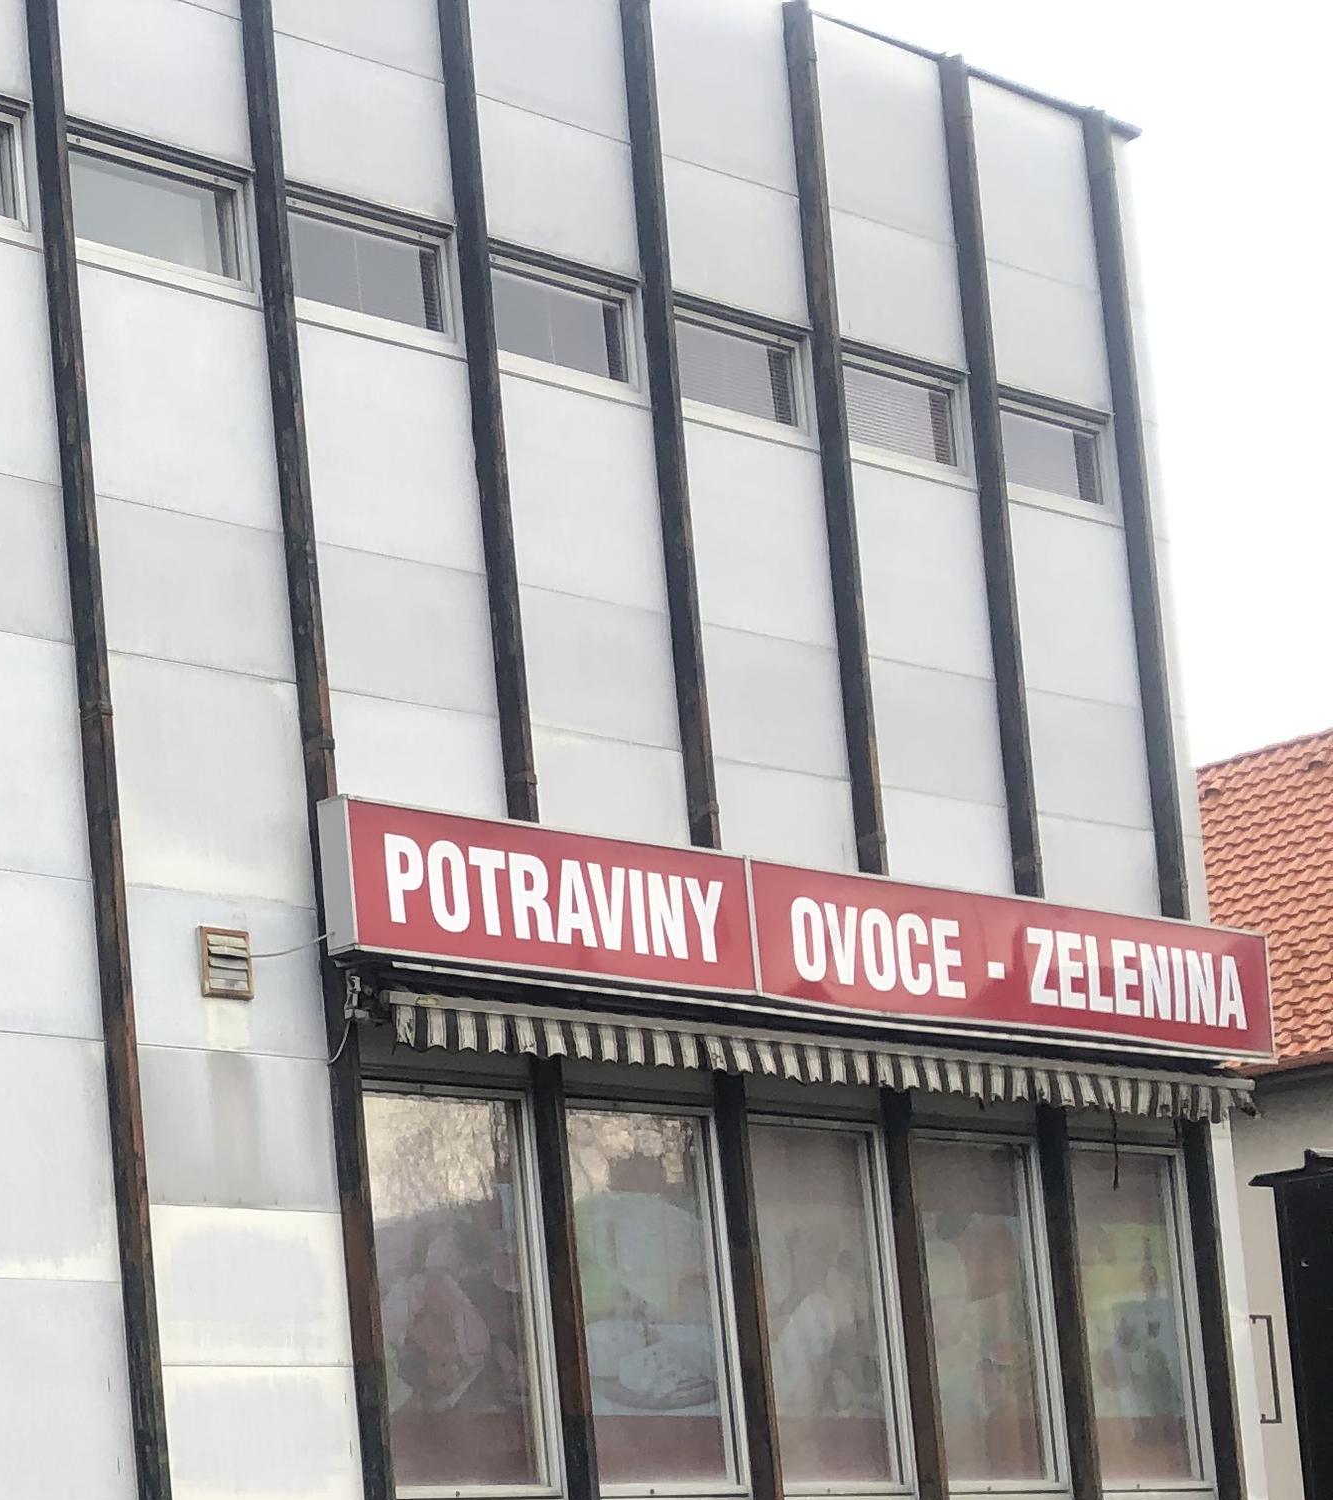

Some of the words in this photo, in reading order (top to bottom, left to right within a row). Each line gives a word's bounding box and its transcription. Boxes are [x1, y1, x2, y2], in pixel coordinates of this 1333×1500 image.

[384, 832, 724, 963] POTRAVINY
[790, 896, 967, 999] OVOCE
[1026, 926, 1248, 1031] ZELENINA
